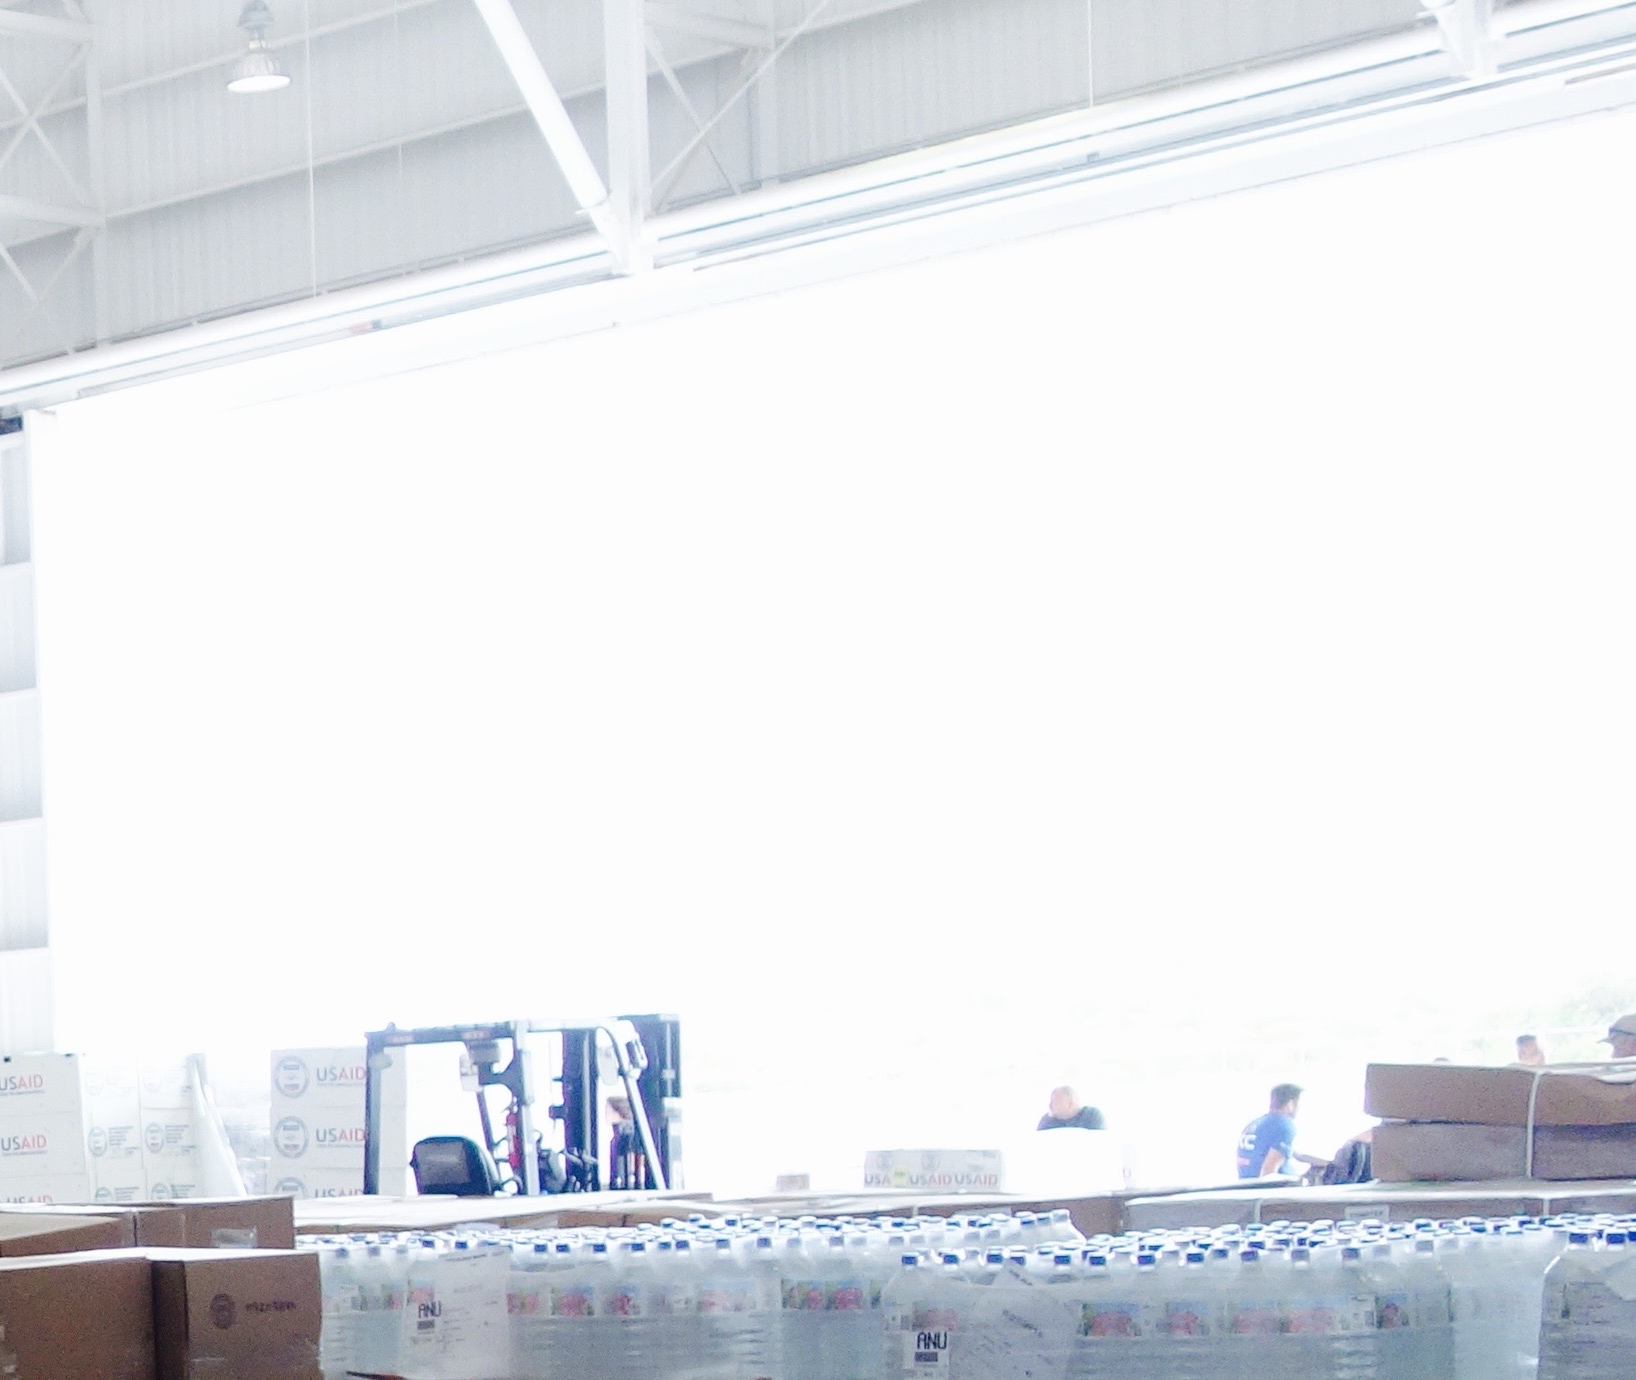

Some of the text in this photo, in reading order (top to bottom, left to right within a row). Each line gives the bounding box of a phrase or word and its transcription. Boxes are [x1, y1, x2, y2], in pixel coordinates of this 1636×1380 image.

[315, 1066, 367, 1082] USAID
[0, 1134, 47, 1151] USAID
[315, 1127, 368, 1143] USAID
[864, 1173, 999, 1186] USA USAID USAID
[916, 1331, 948, 1350] ANU
